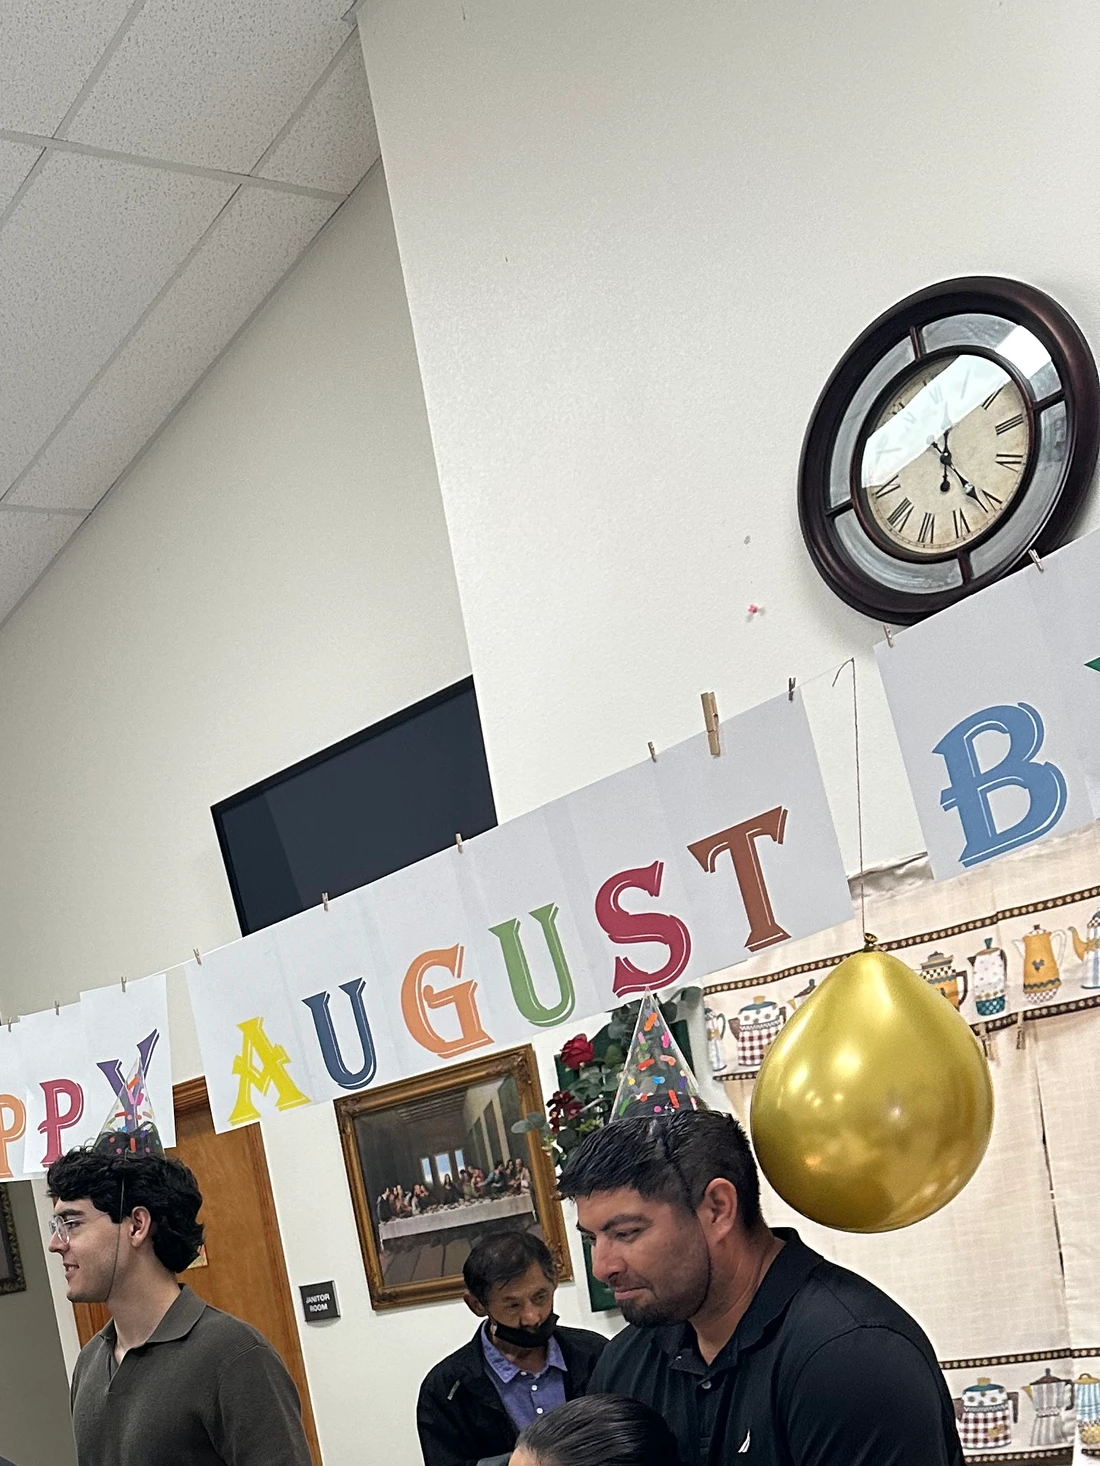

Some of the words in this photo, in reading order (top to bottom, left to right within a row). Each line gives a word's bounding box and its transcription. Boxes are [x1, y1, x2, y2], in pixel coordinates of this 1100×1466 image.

[995, 413, 1024, 436] III
[886, 496, 915, 533] VIII
[917, 512, 936, 544] VII
[229, 805, 792, 1126] AUGUST
[305, 1293, 331, 1304] JANITOR
[309, 1303, 328, 1312] ROOM
